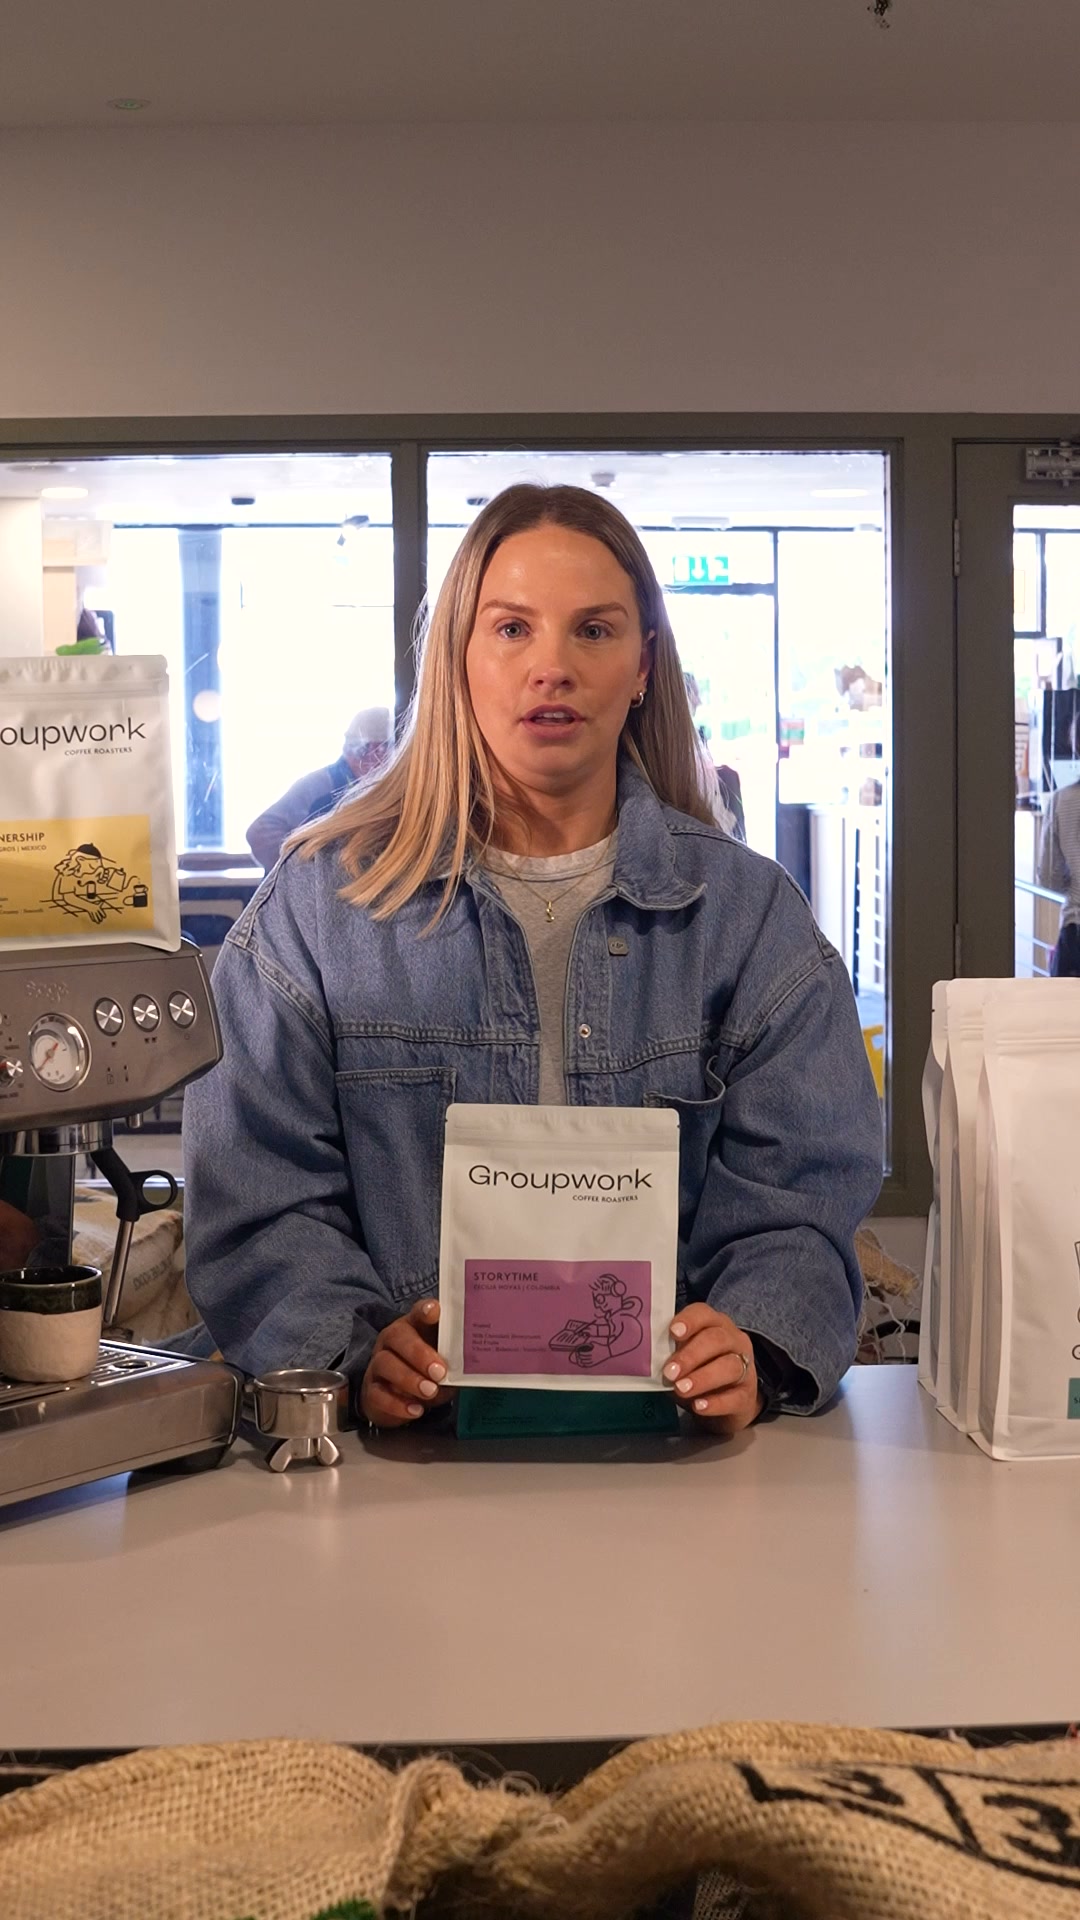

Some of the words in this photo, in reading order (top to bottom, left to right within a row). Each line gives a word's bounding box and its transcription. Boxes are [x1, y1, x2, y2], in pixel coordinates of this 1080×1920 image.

[64, 748, 92, 756] COFFEE
[94, 746, 133, 755] ROASTERS
[468, 1165, 653, 1195] Groupwork
[572, 1195, 600, 1203] COFFEE
[601, 1195, 639, 1203] ROASTERS
[473, 1272, 539, 1281] STORYTIME
